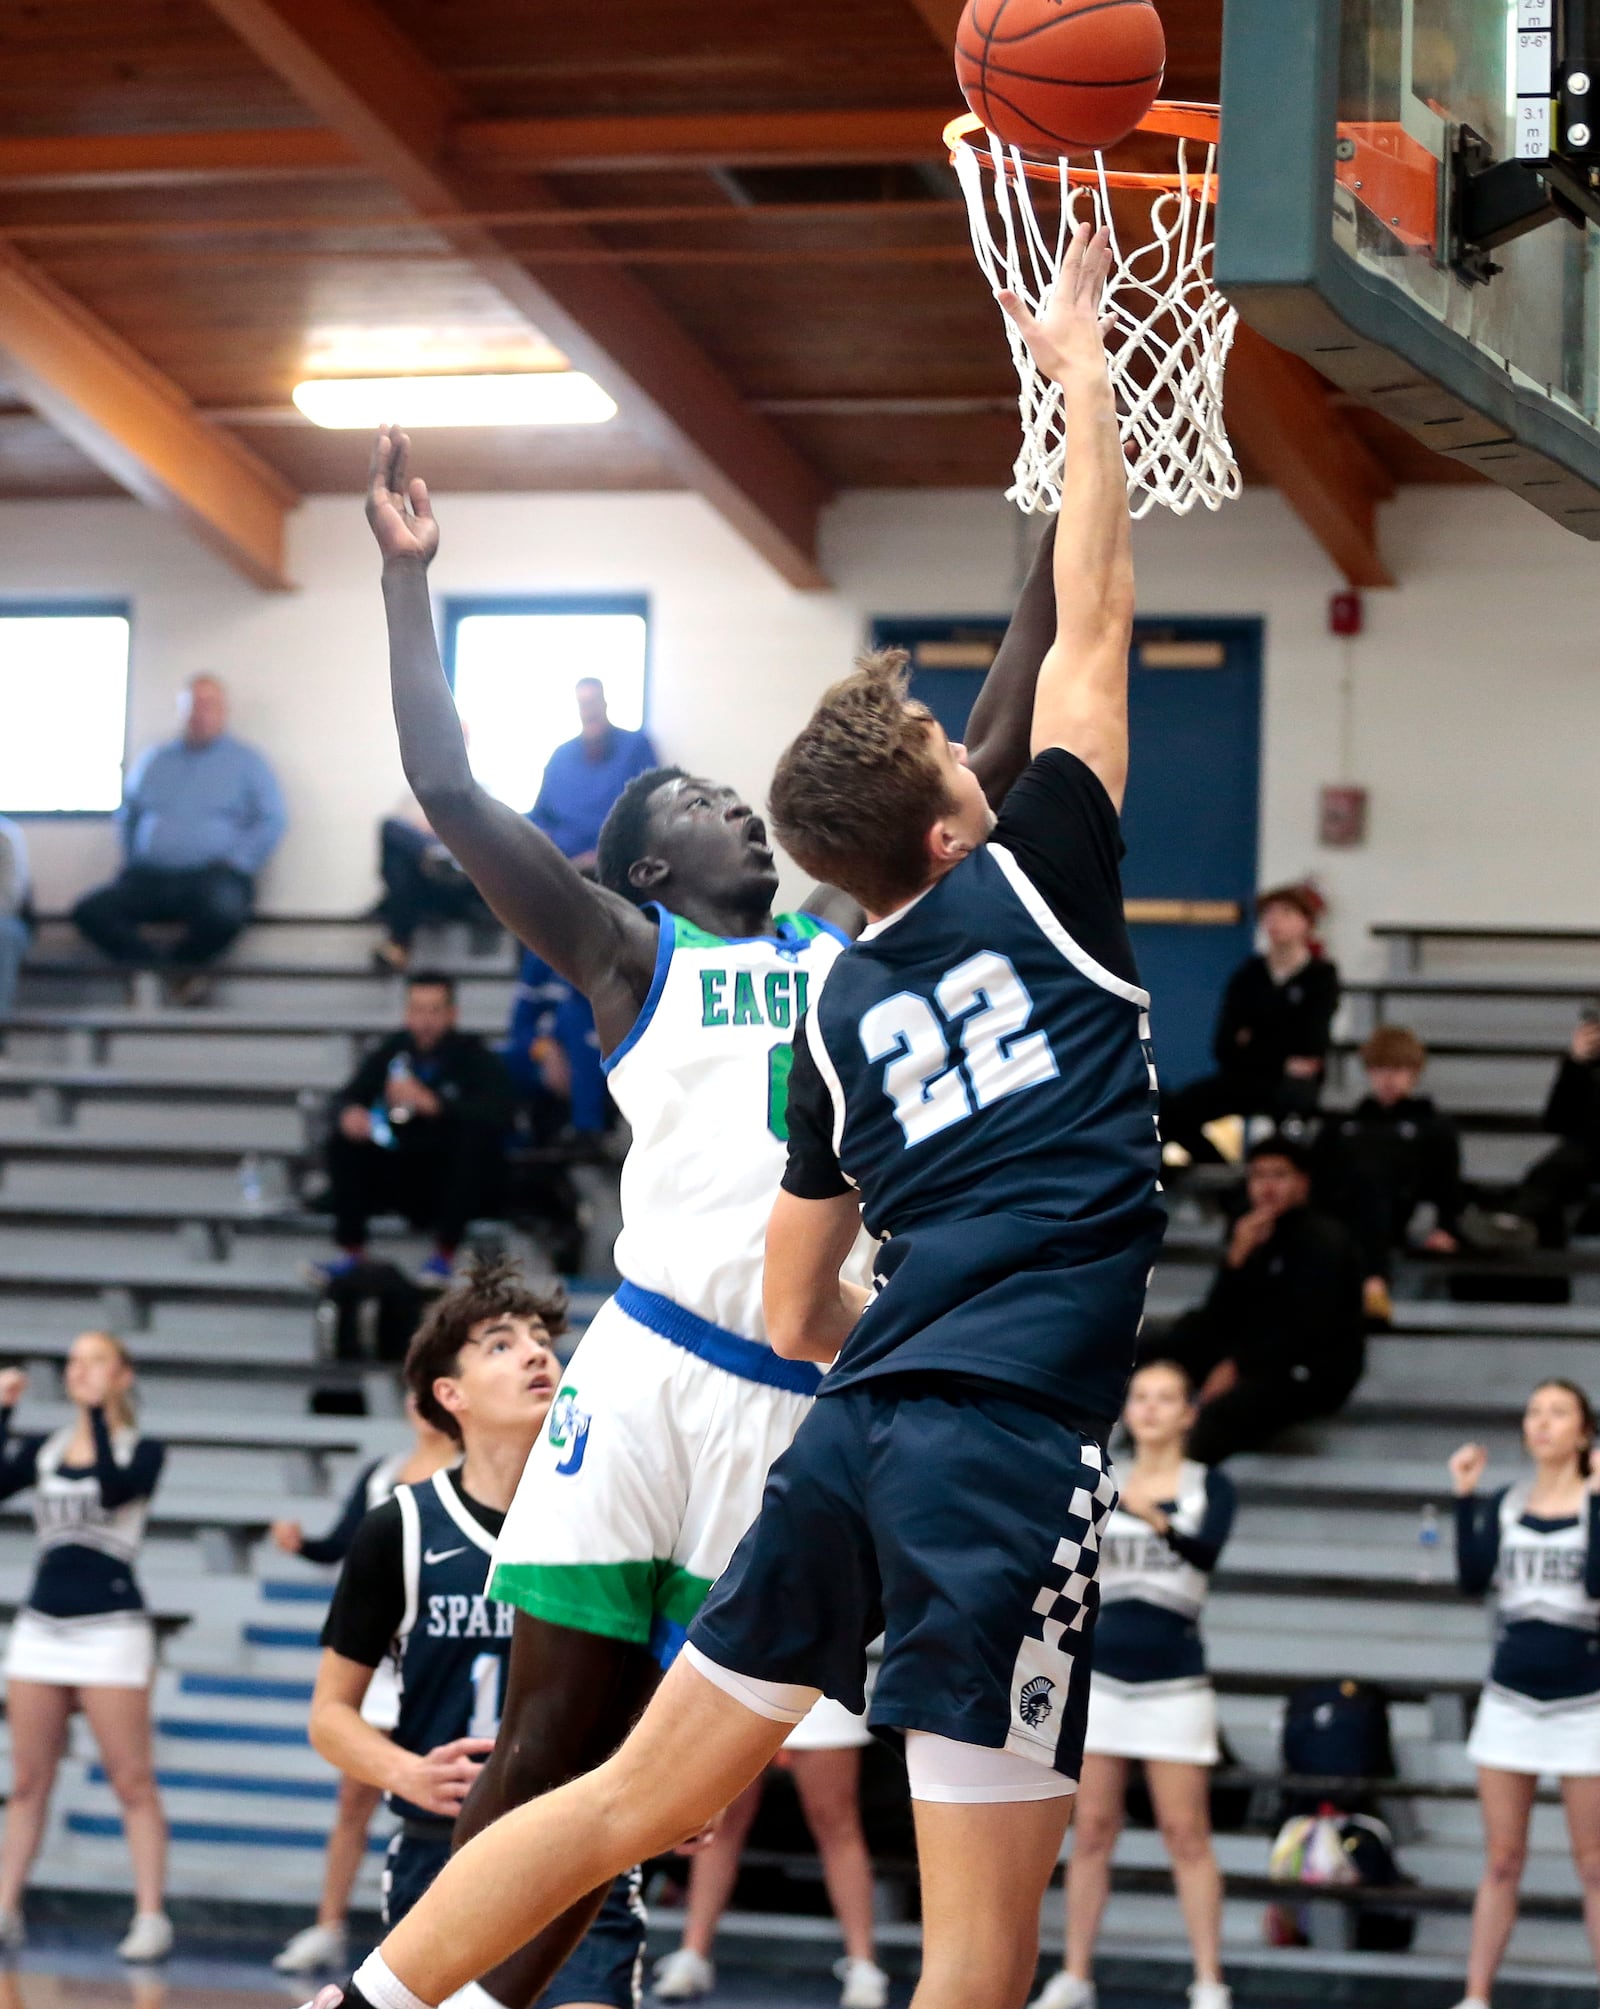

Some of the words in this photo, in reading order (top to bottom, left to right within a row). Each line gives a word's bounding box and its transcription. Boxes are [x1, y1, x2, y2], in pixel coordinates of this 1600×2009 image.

[1528, 17, 1541, 26] m
[1523, 108, 1544, 119] 3.1
[1527, 128, 1540, 137] m
[858, 949, 1061, 1149] 22
